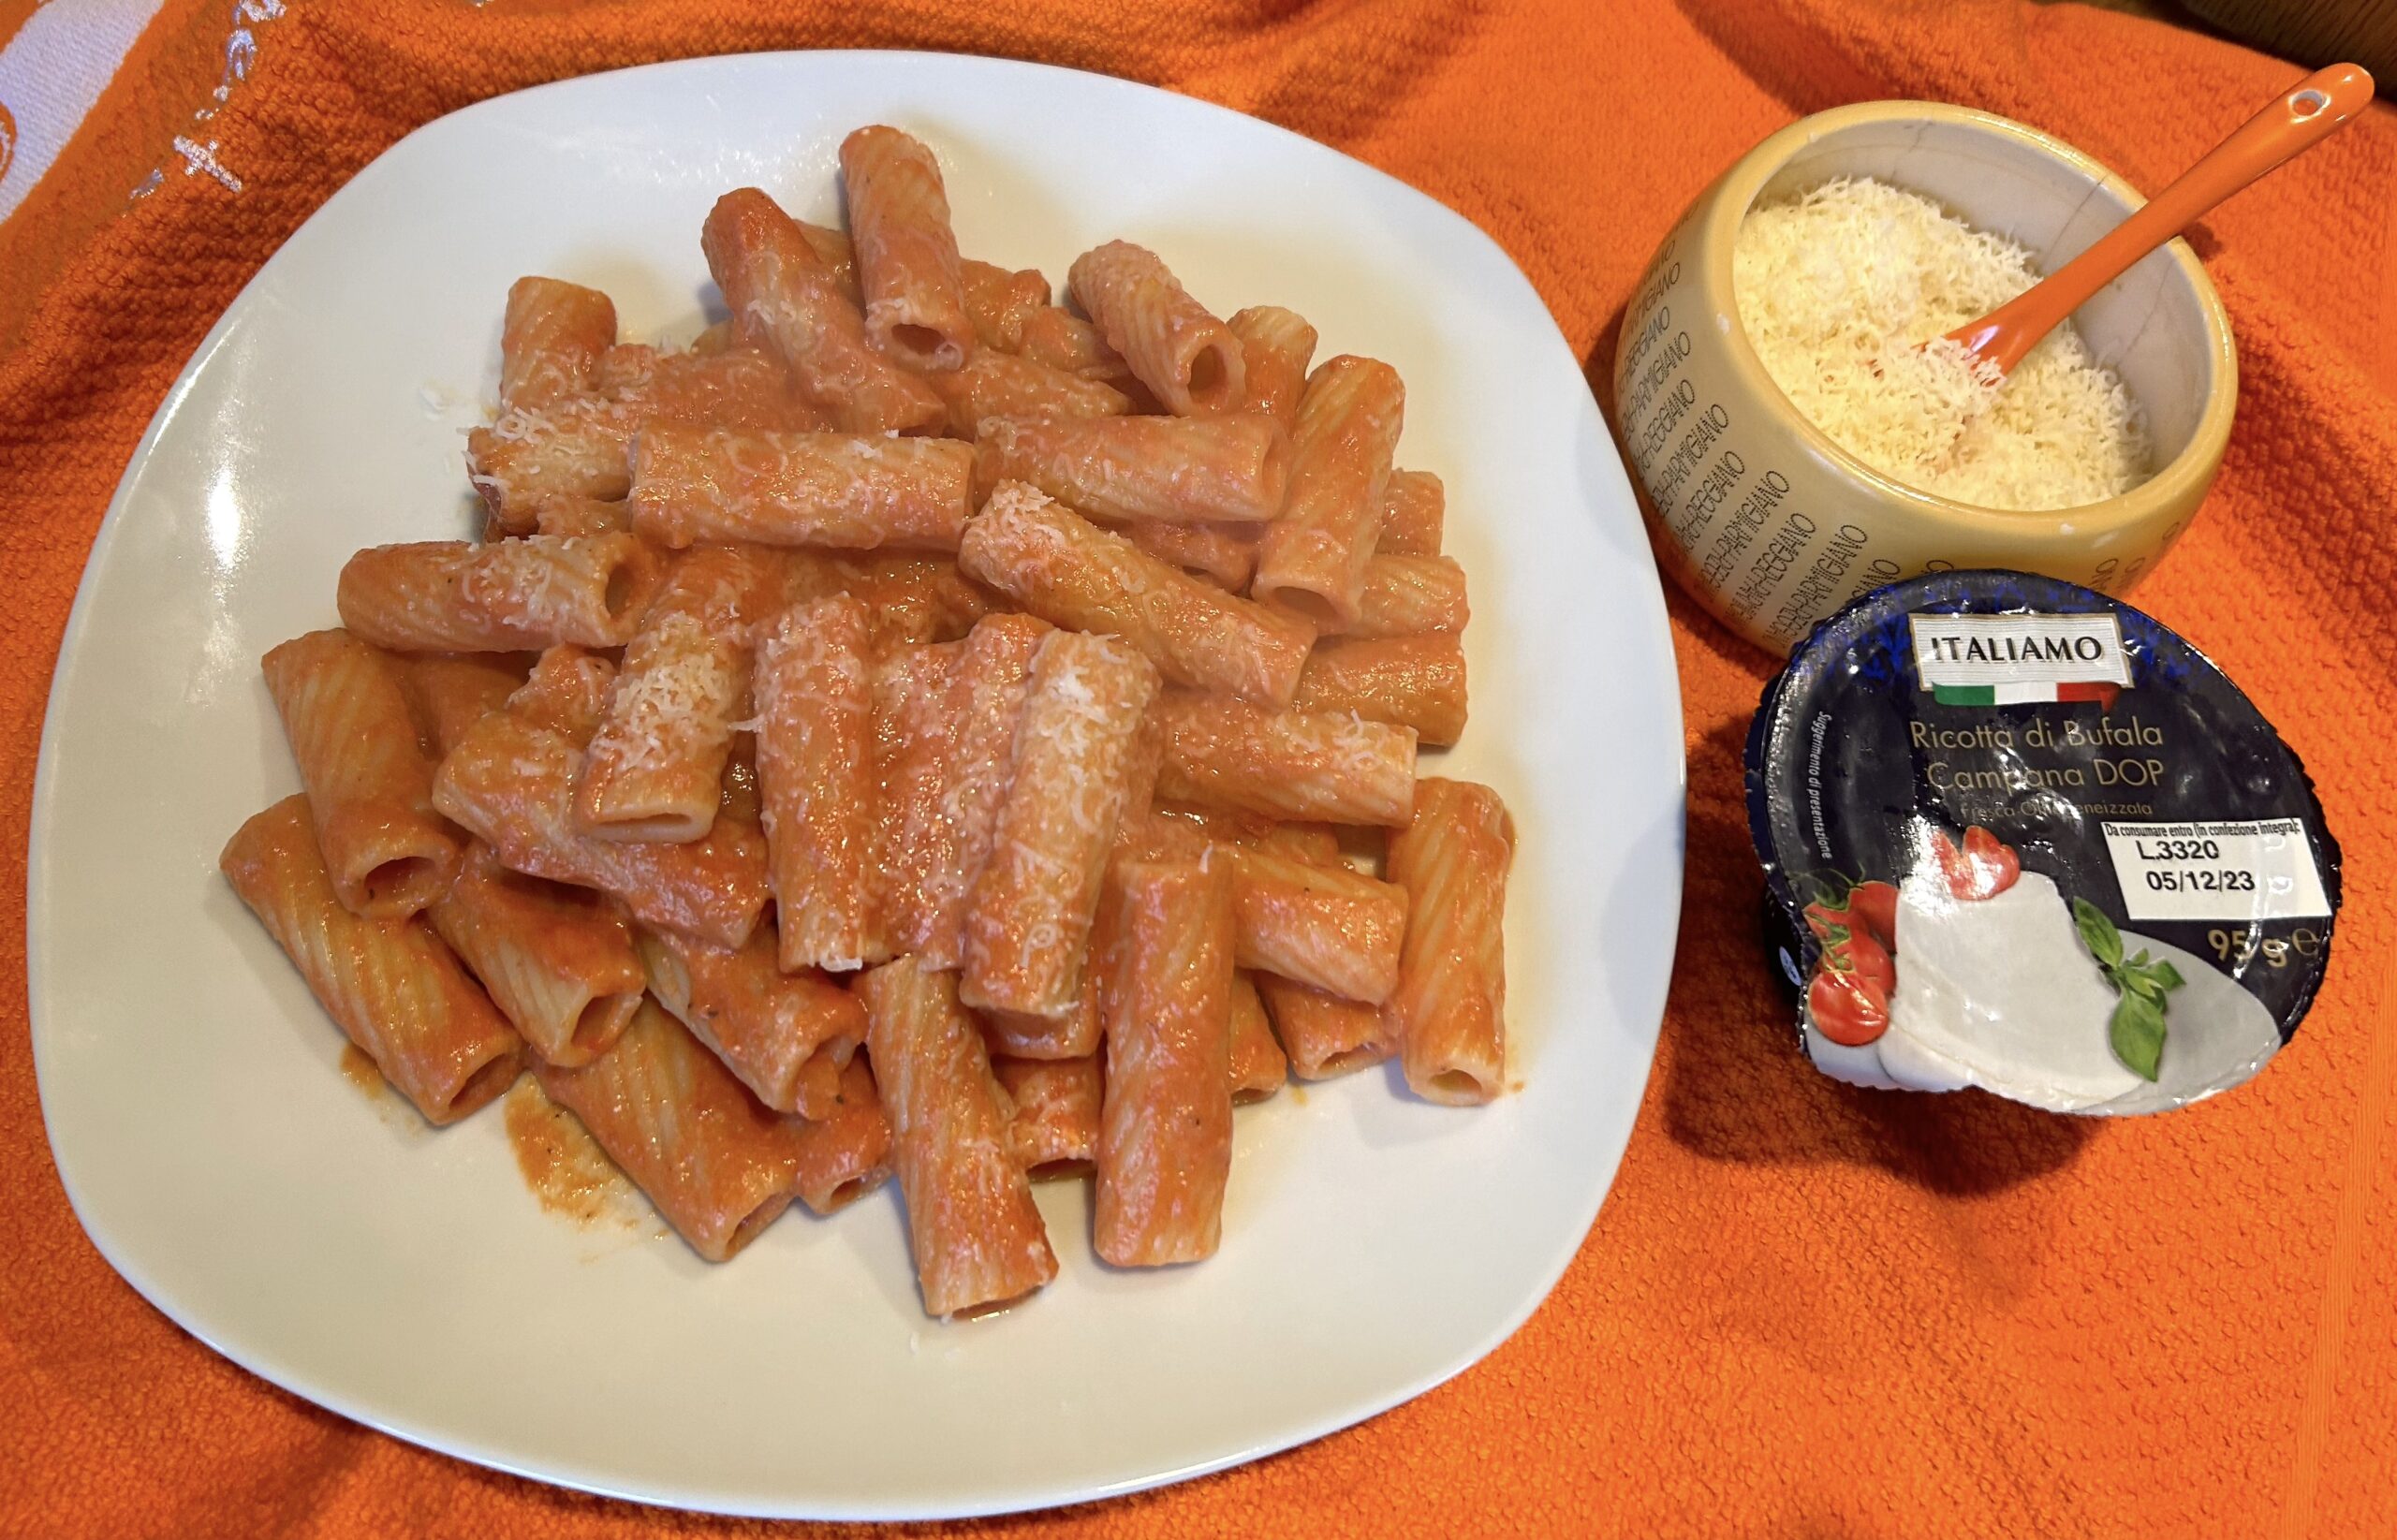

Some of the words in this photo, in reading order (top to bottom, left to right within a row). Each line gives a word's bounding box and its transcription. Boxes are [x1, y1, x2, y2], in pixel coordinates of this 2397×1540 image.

[1931, 636, 2103, 662] ITALIAMO
[1808, 711, 1832, 776] Suggerimento
[1909, 720, 2012, 748] Ricotta
[2025, 718, 2054, 747] di
[2063, 715, 2164, 746] Bufala
[1808, 776, 1823, 789] di
[1927, 760, 2085, 797] Campana
[2093, 758, 2165, 786] DOP
[1806, 788, 1833, 859] presentazione
[2104, 823, 2120, 836] Da
[2120, 825, 2168, 837] consumare
[2169, 825, 2194, 837] entro
[2209, 823, 2257, 837] confezione
[2135, 840, 2220, 860] L.3320
[2145, 870, 2256, 892] 05/12/23
